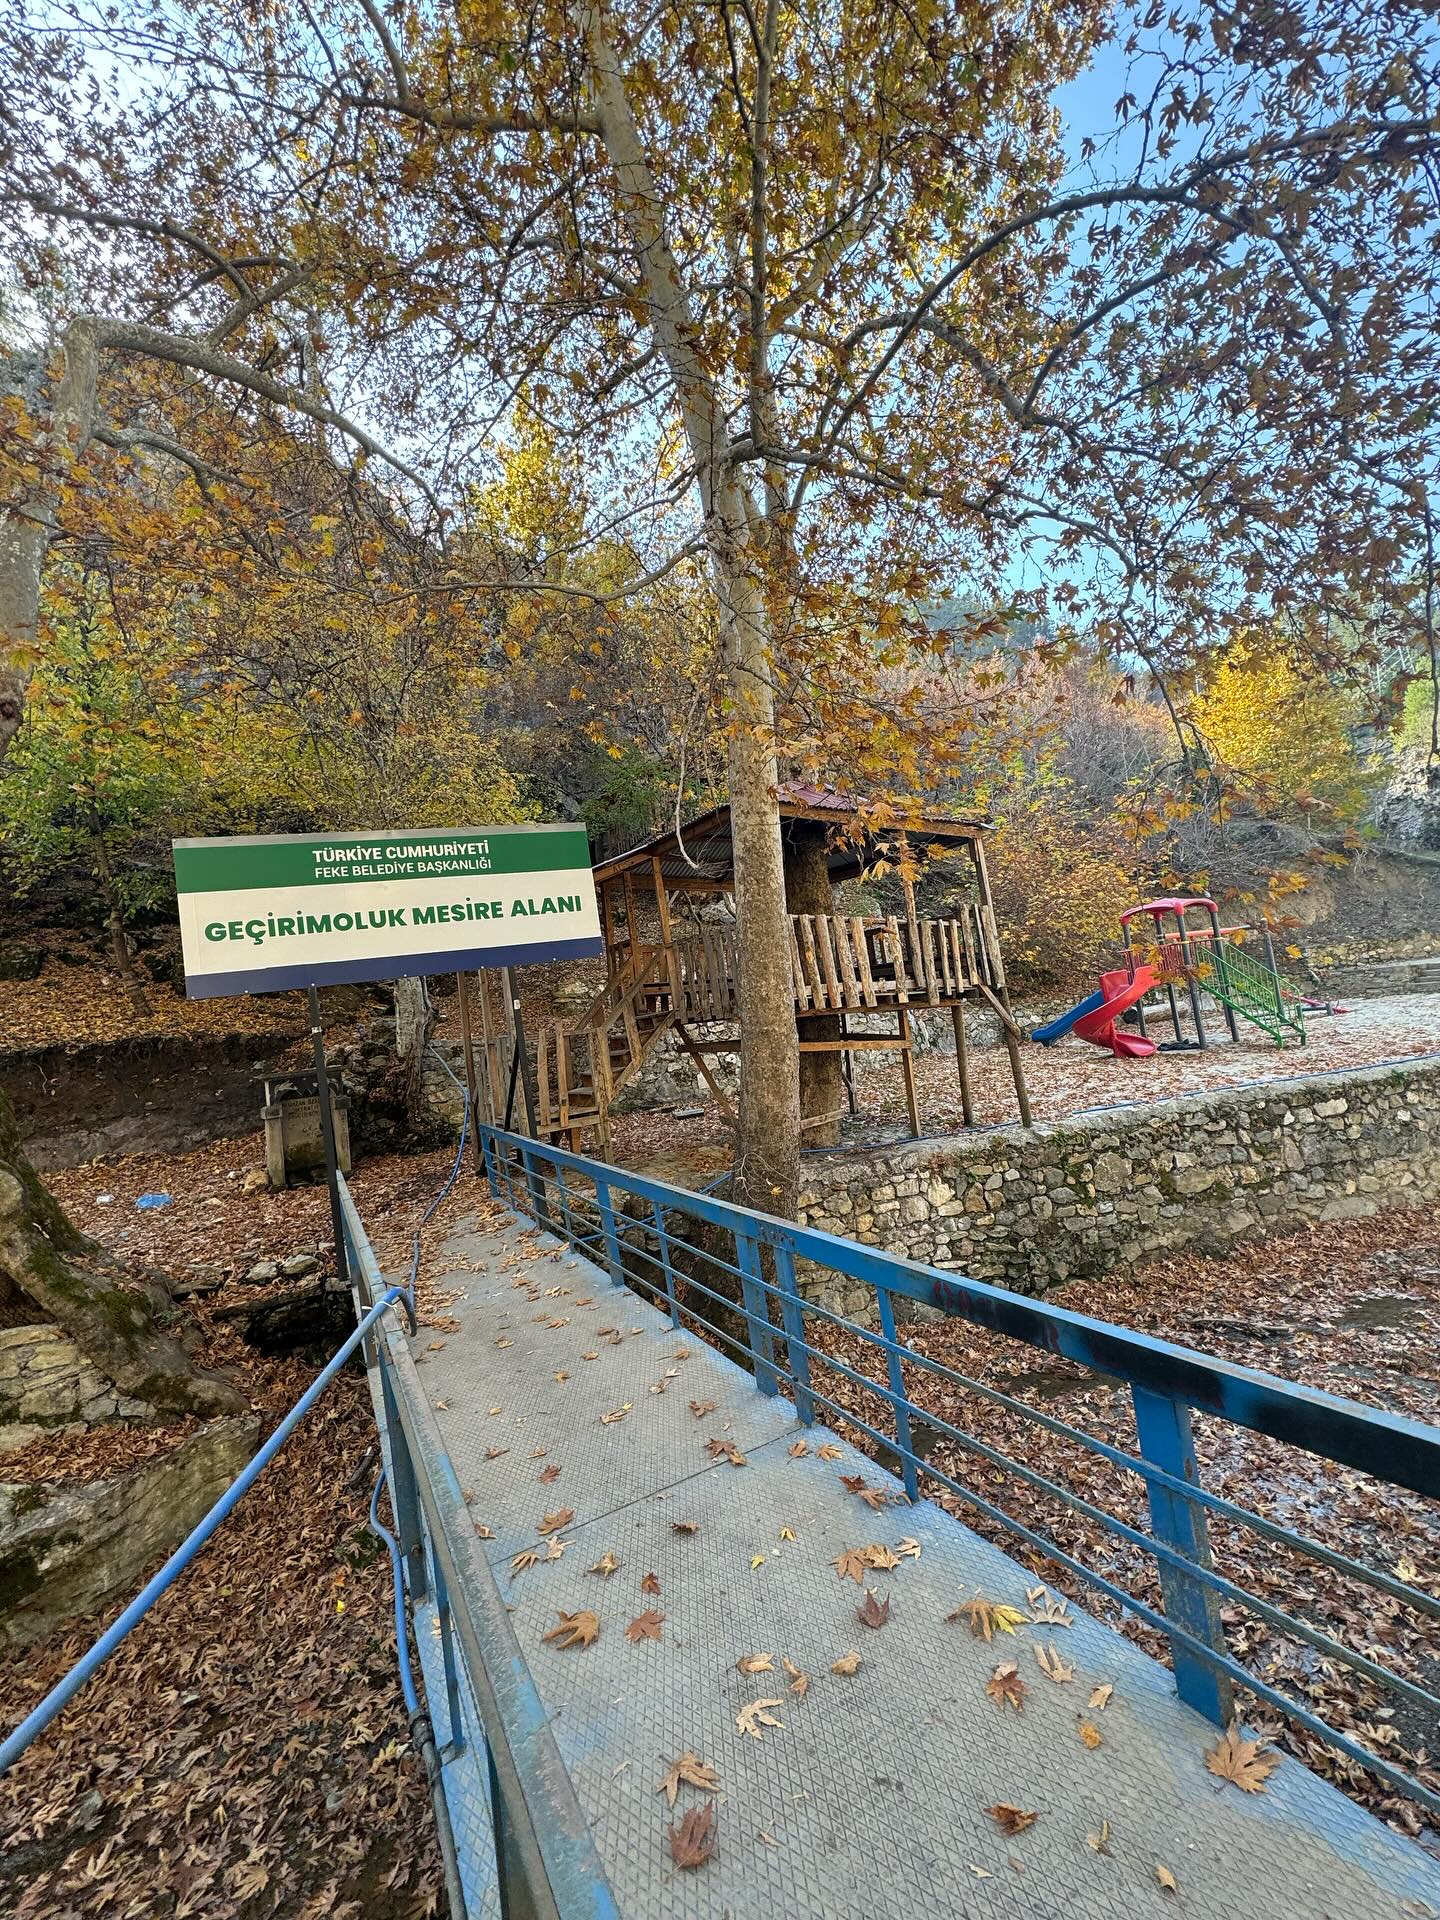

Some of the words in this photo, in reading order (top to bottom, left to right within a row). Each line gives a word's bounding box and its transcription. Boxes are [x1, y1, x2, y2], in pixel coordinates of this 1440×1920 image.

[312, 845, 382, 863] TÜRKİYE
[386, 840, 489, 859] CUMHURİYETİ
[315, 865, 349, 879] FEKE
[352, 861, 415, 876] BELEDİYE
[418, 857, 492, 874] BAŞKANLIĞI
[204, 908, 408, 946] GEÇİRİMOLUK
[412, 897, 504, 925] MESİRE
[511, 895, 582, 918] ALANI
